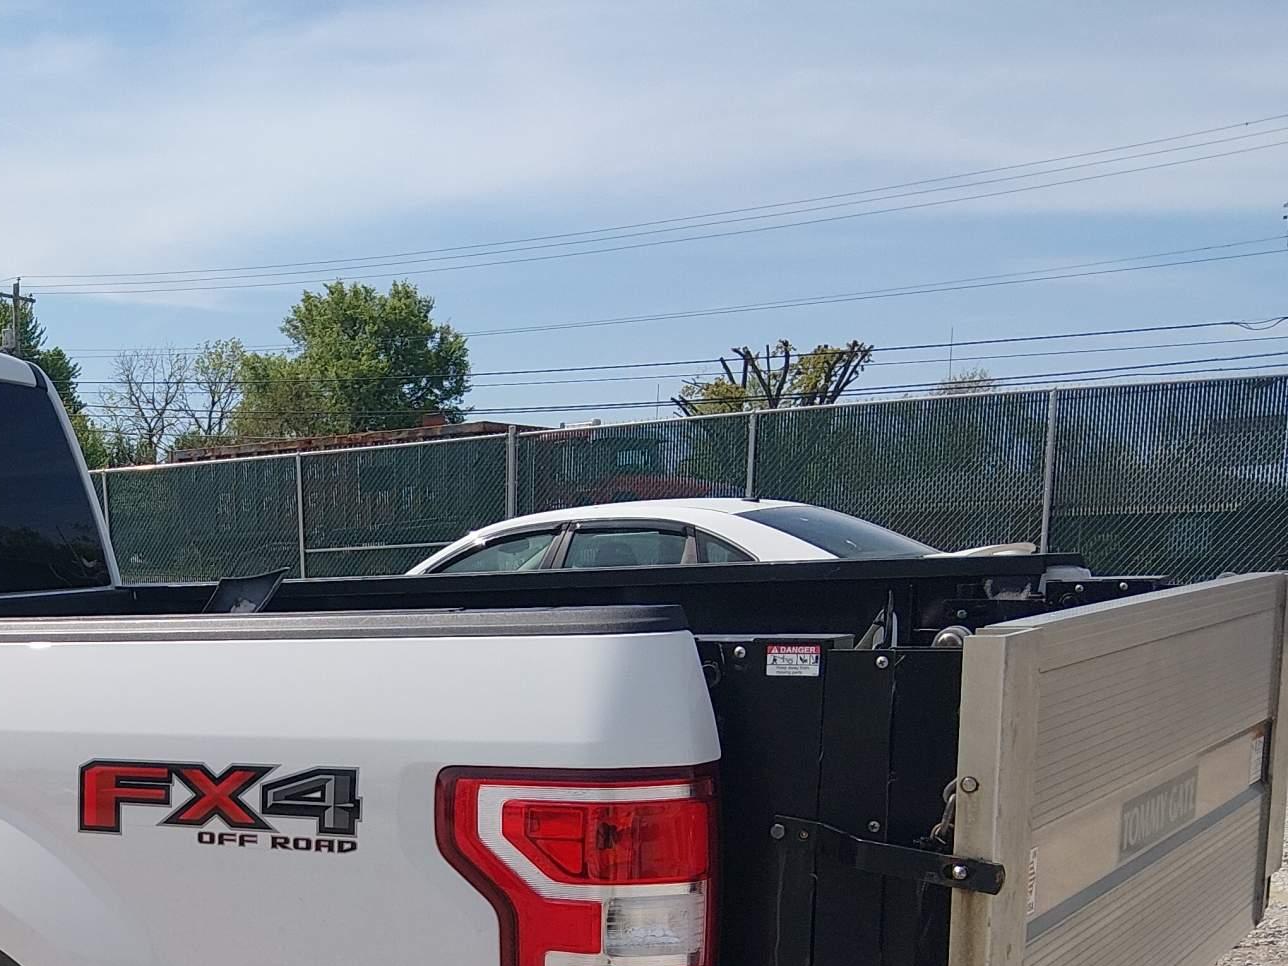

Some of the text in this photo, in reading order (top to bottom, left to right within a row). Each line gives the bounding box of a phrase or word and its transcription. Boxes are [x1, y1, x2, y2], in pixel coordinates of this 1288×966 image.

[780, 646, 816, 654] DANGER
[78, 758, 363, 838] FX4
[197, 831, 358, 854] OFF ROAD
